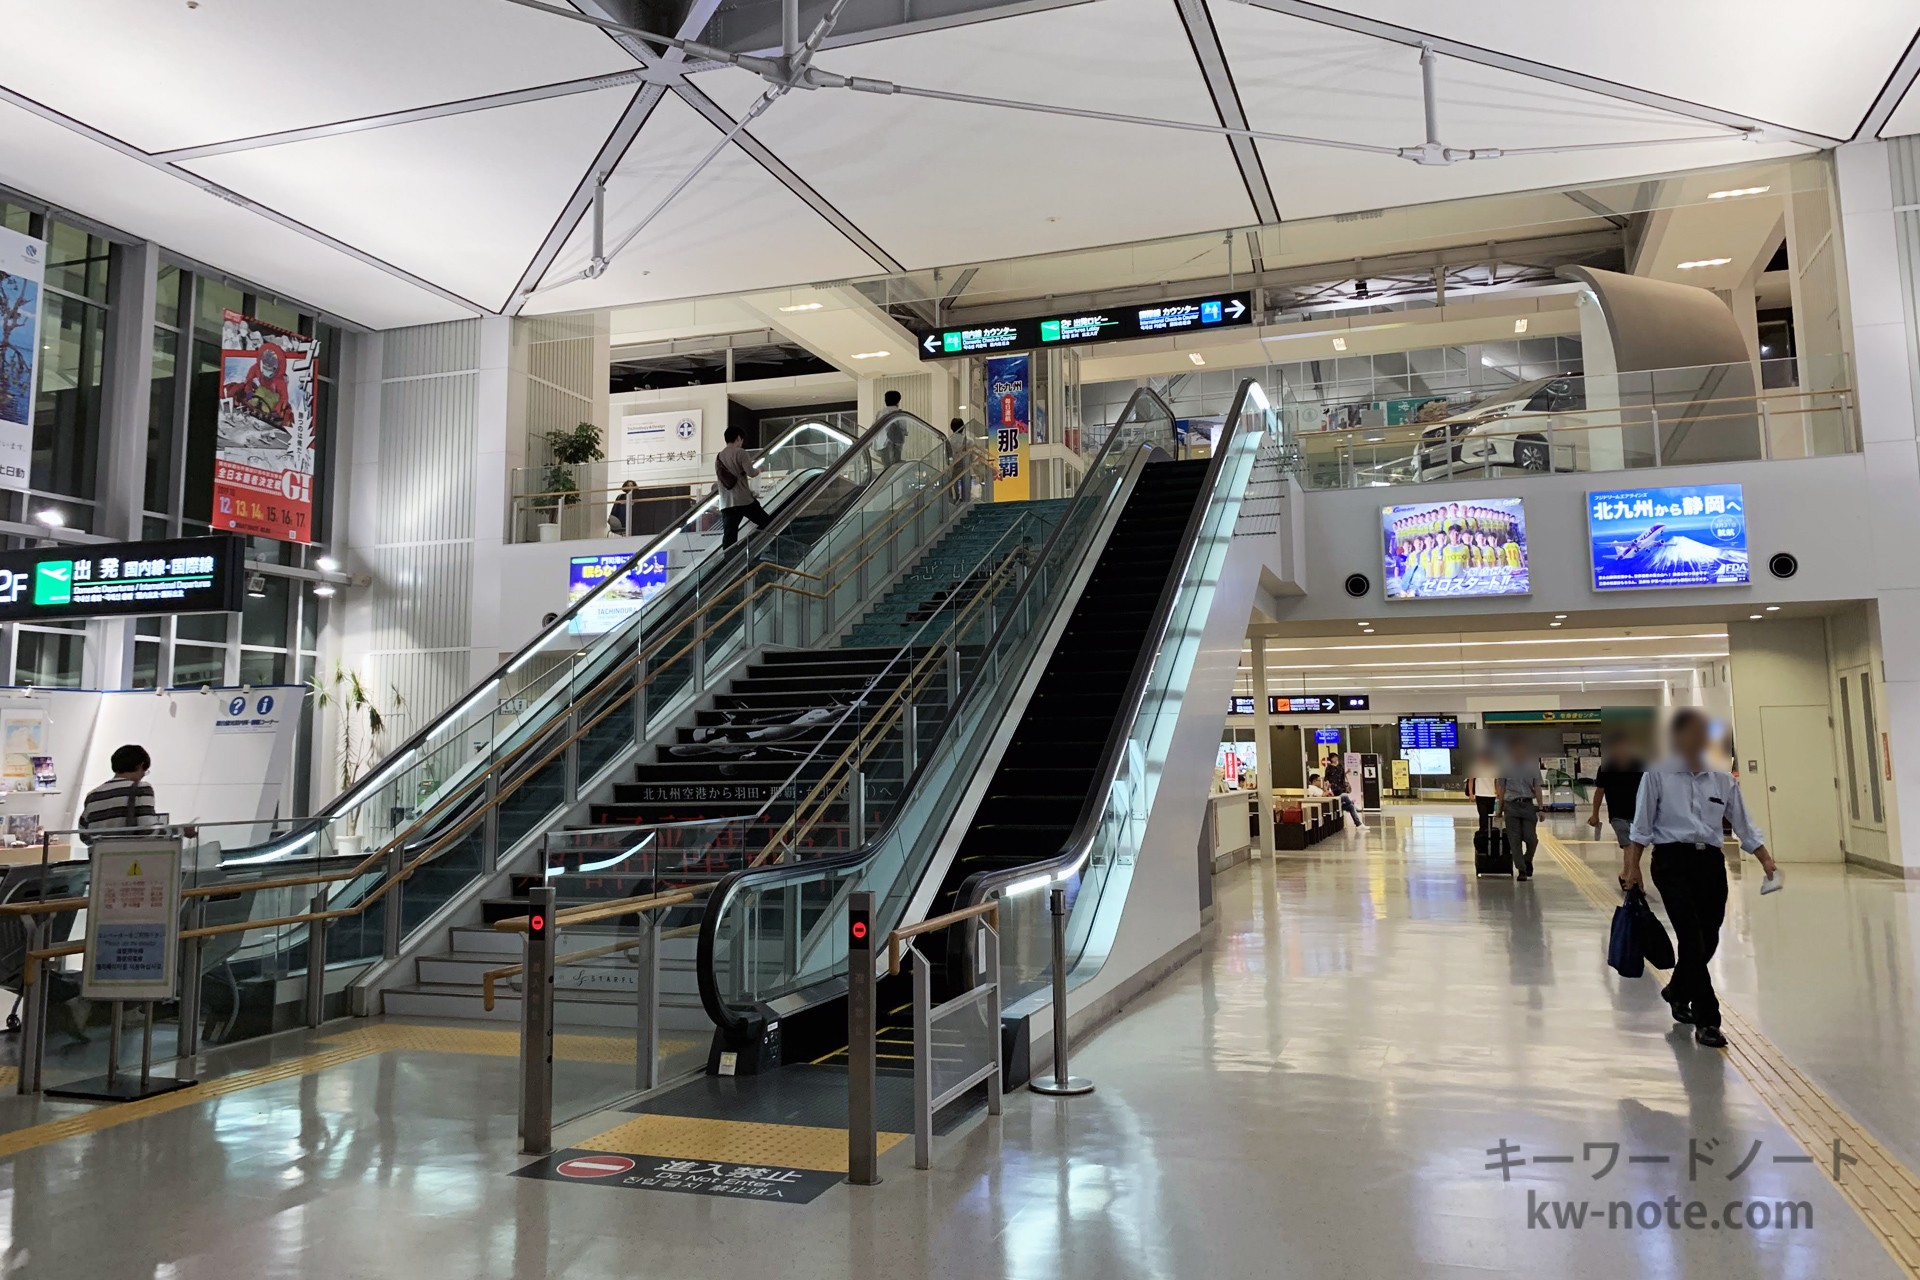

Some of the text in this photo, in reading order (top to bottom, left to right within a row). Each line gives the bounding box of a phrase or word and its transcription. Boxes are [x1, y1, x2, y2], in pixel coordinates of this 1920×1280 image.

[1163, 306, 1198, 316] カウンター
[984, 326, 1016, 337] カウンター
[994, 380, 1022, 393] 北九州
[626, 450, 697, 465] 西日本工業大学
[998, 428, 1019, 478] 那覇
[1593, 495, 1742, 520] 北九州から静岡へ
[74, 558, 120, 580] 出発
[1726, 563, 1747, 572] FDA
[0, 569, 28, 602] 2F
[1422, 576, 1511, 592] ゼロスタート!!
[654, 1160, 802, 1183] 進入禁止
[656, 1172, 775, 1188] Do Not Enter
